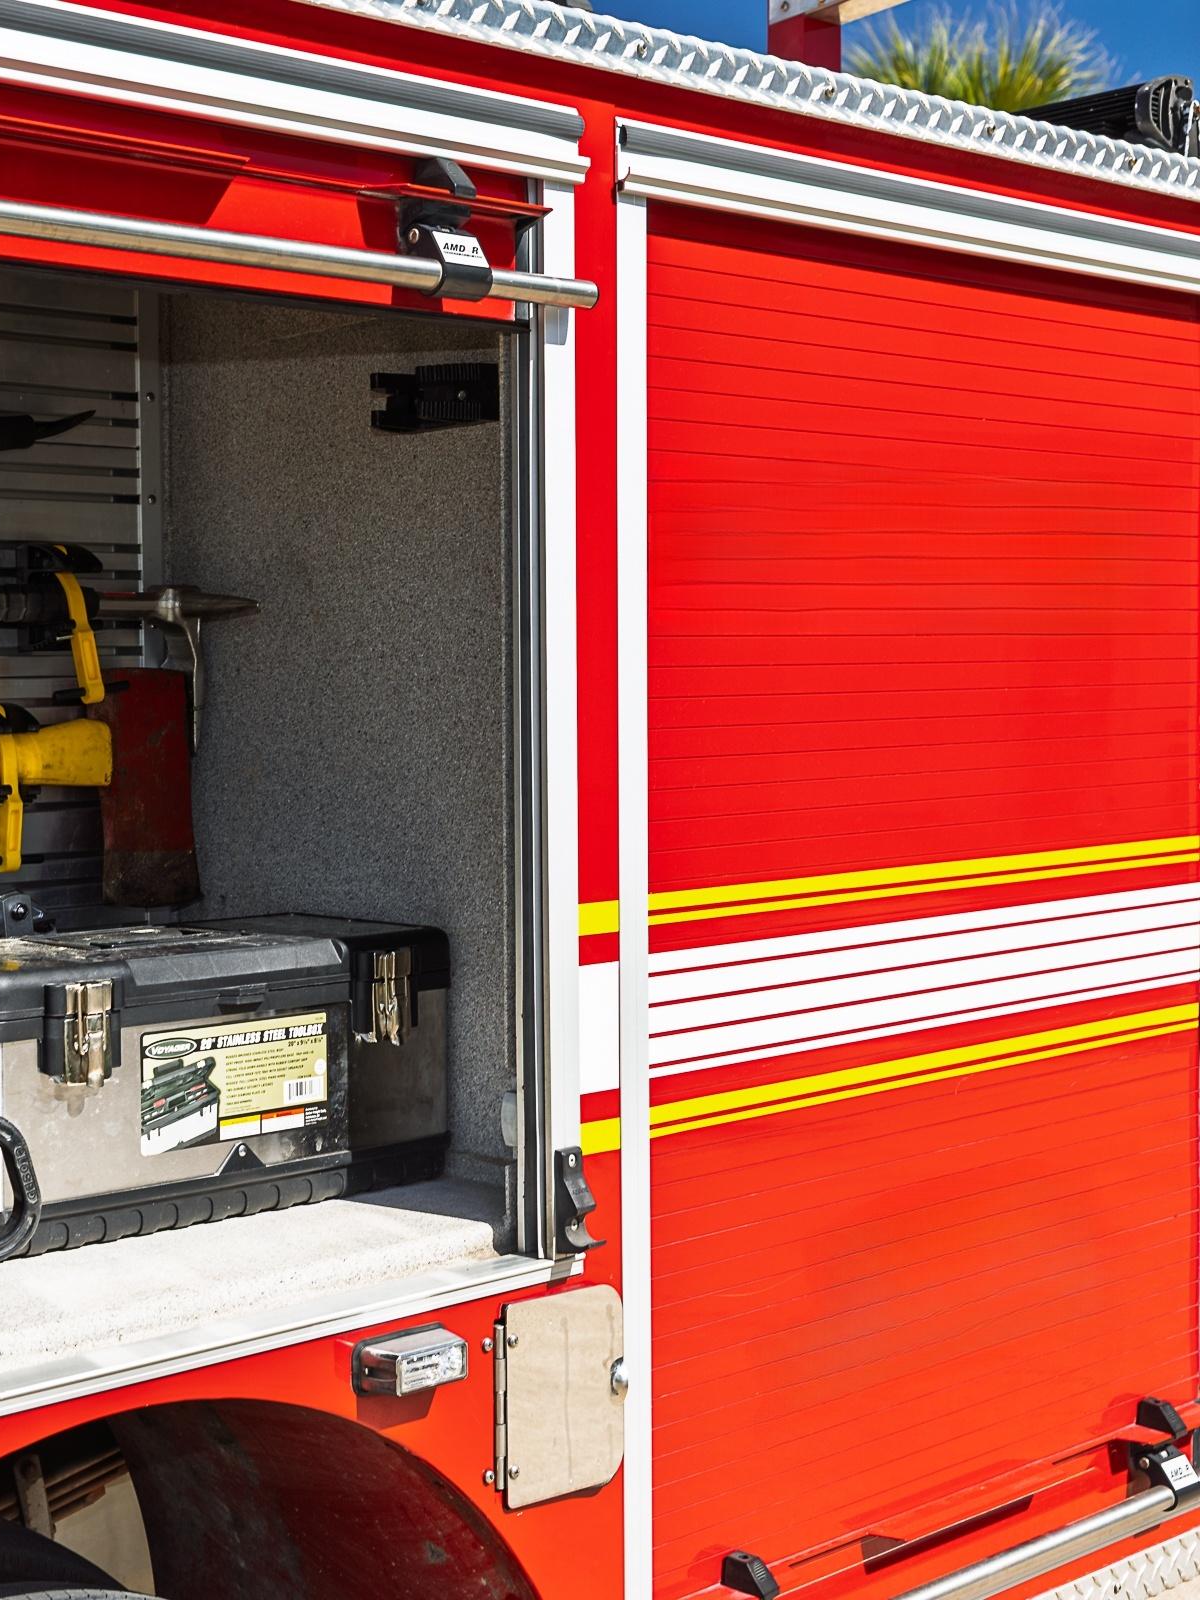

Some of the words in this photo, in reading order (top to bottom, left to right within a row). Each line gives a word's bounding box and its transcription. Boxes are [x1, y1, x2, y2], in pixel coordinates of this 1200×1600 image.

[443, 242, 465, 252] AMD
[216, 1031, 261, 1048] STAINLESS
[262, 1028, 287, 1044] STEEL
[288, 1023, 323, 1039] TOOLBOX
[16, 1146, 38, 1202] CLOSED
